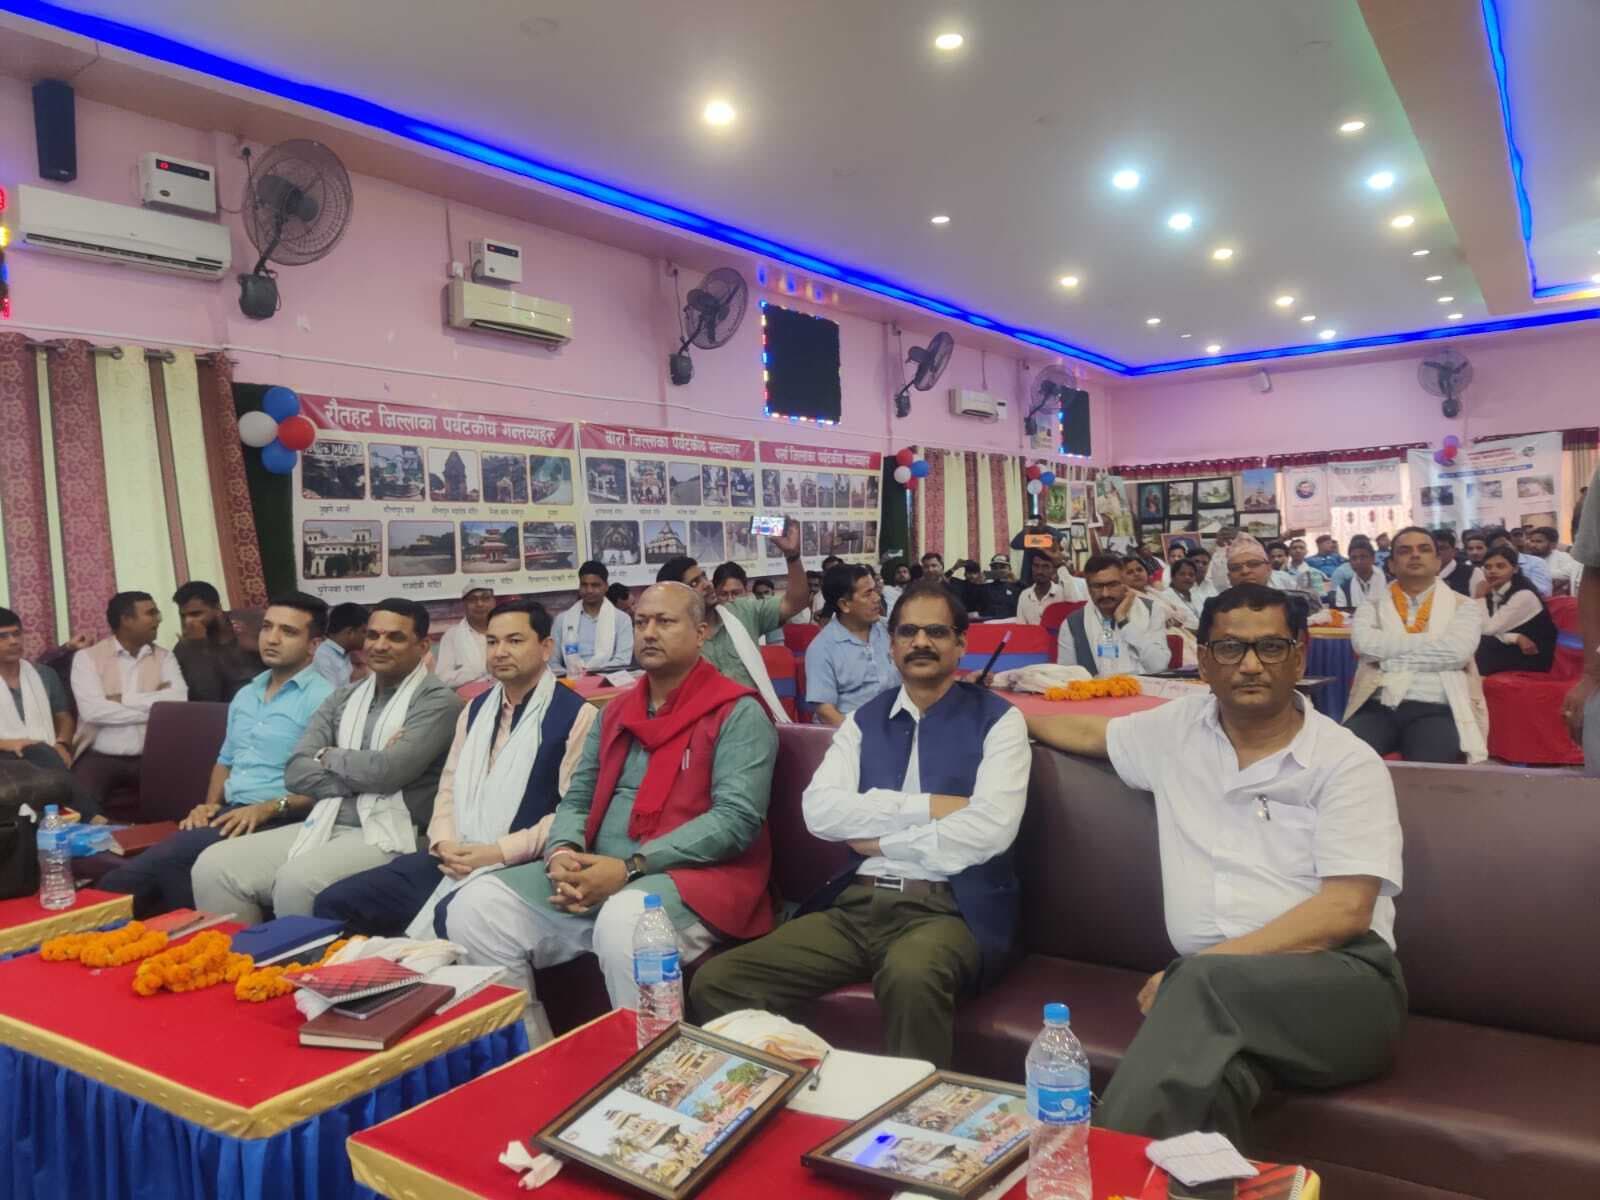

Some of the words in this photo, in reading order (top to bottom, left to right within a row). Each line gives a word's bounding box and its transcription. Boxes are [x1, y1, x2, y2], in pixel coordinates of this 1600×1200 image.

[324, 398, 373, 428] रौतहट
[378, 404, 437, 432] जिल्लाका
[442, 412, 498, 438] पर्यटकीय
